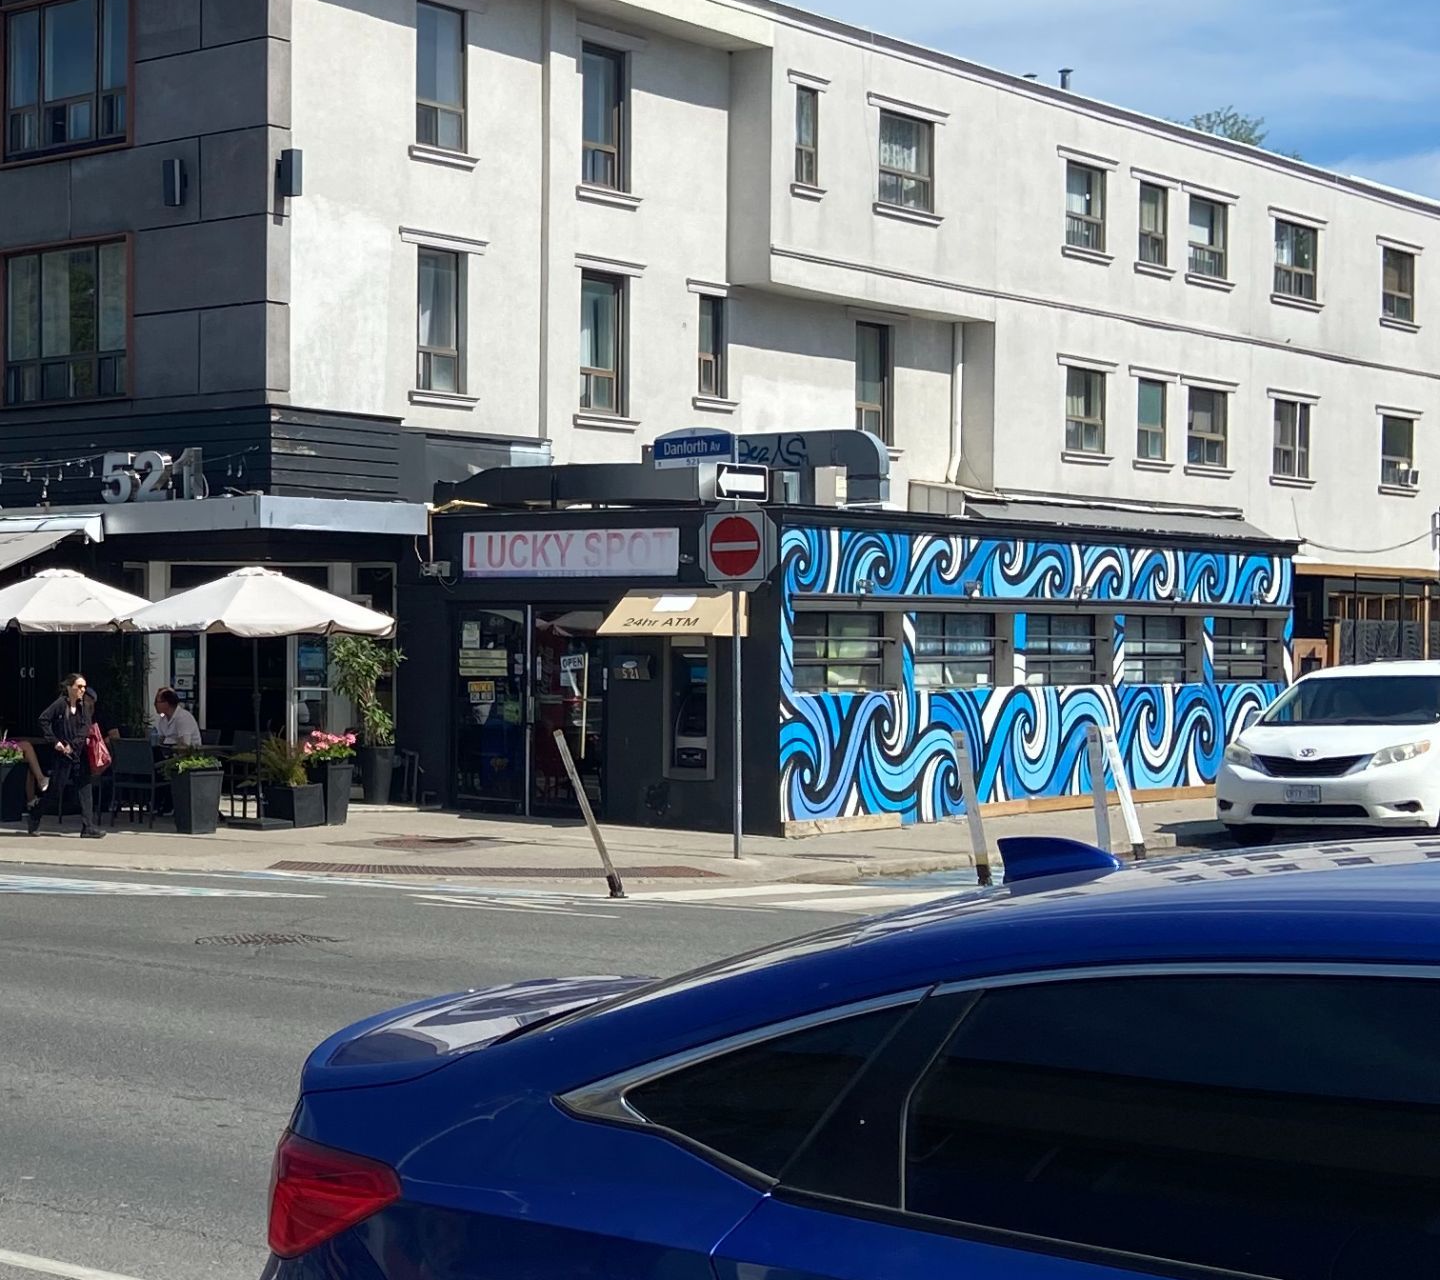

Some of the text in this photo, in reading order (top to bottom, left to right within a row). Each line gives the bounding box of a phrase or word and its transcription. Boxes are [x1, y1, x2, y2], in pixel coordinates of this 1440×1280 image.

[664, 439, 721, 456] Danforth Av
[101, 447, 203, 504] 521
[468, 531, 674, 569] LUCKY SPOT
[623, 617, 700, 627] 24hr ATM
[562, 657, 583, 668] OPEN
